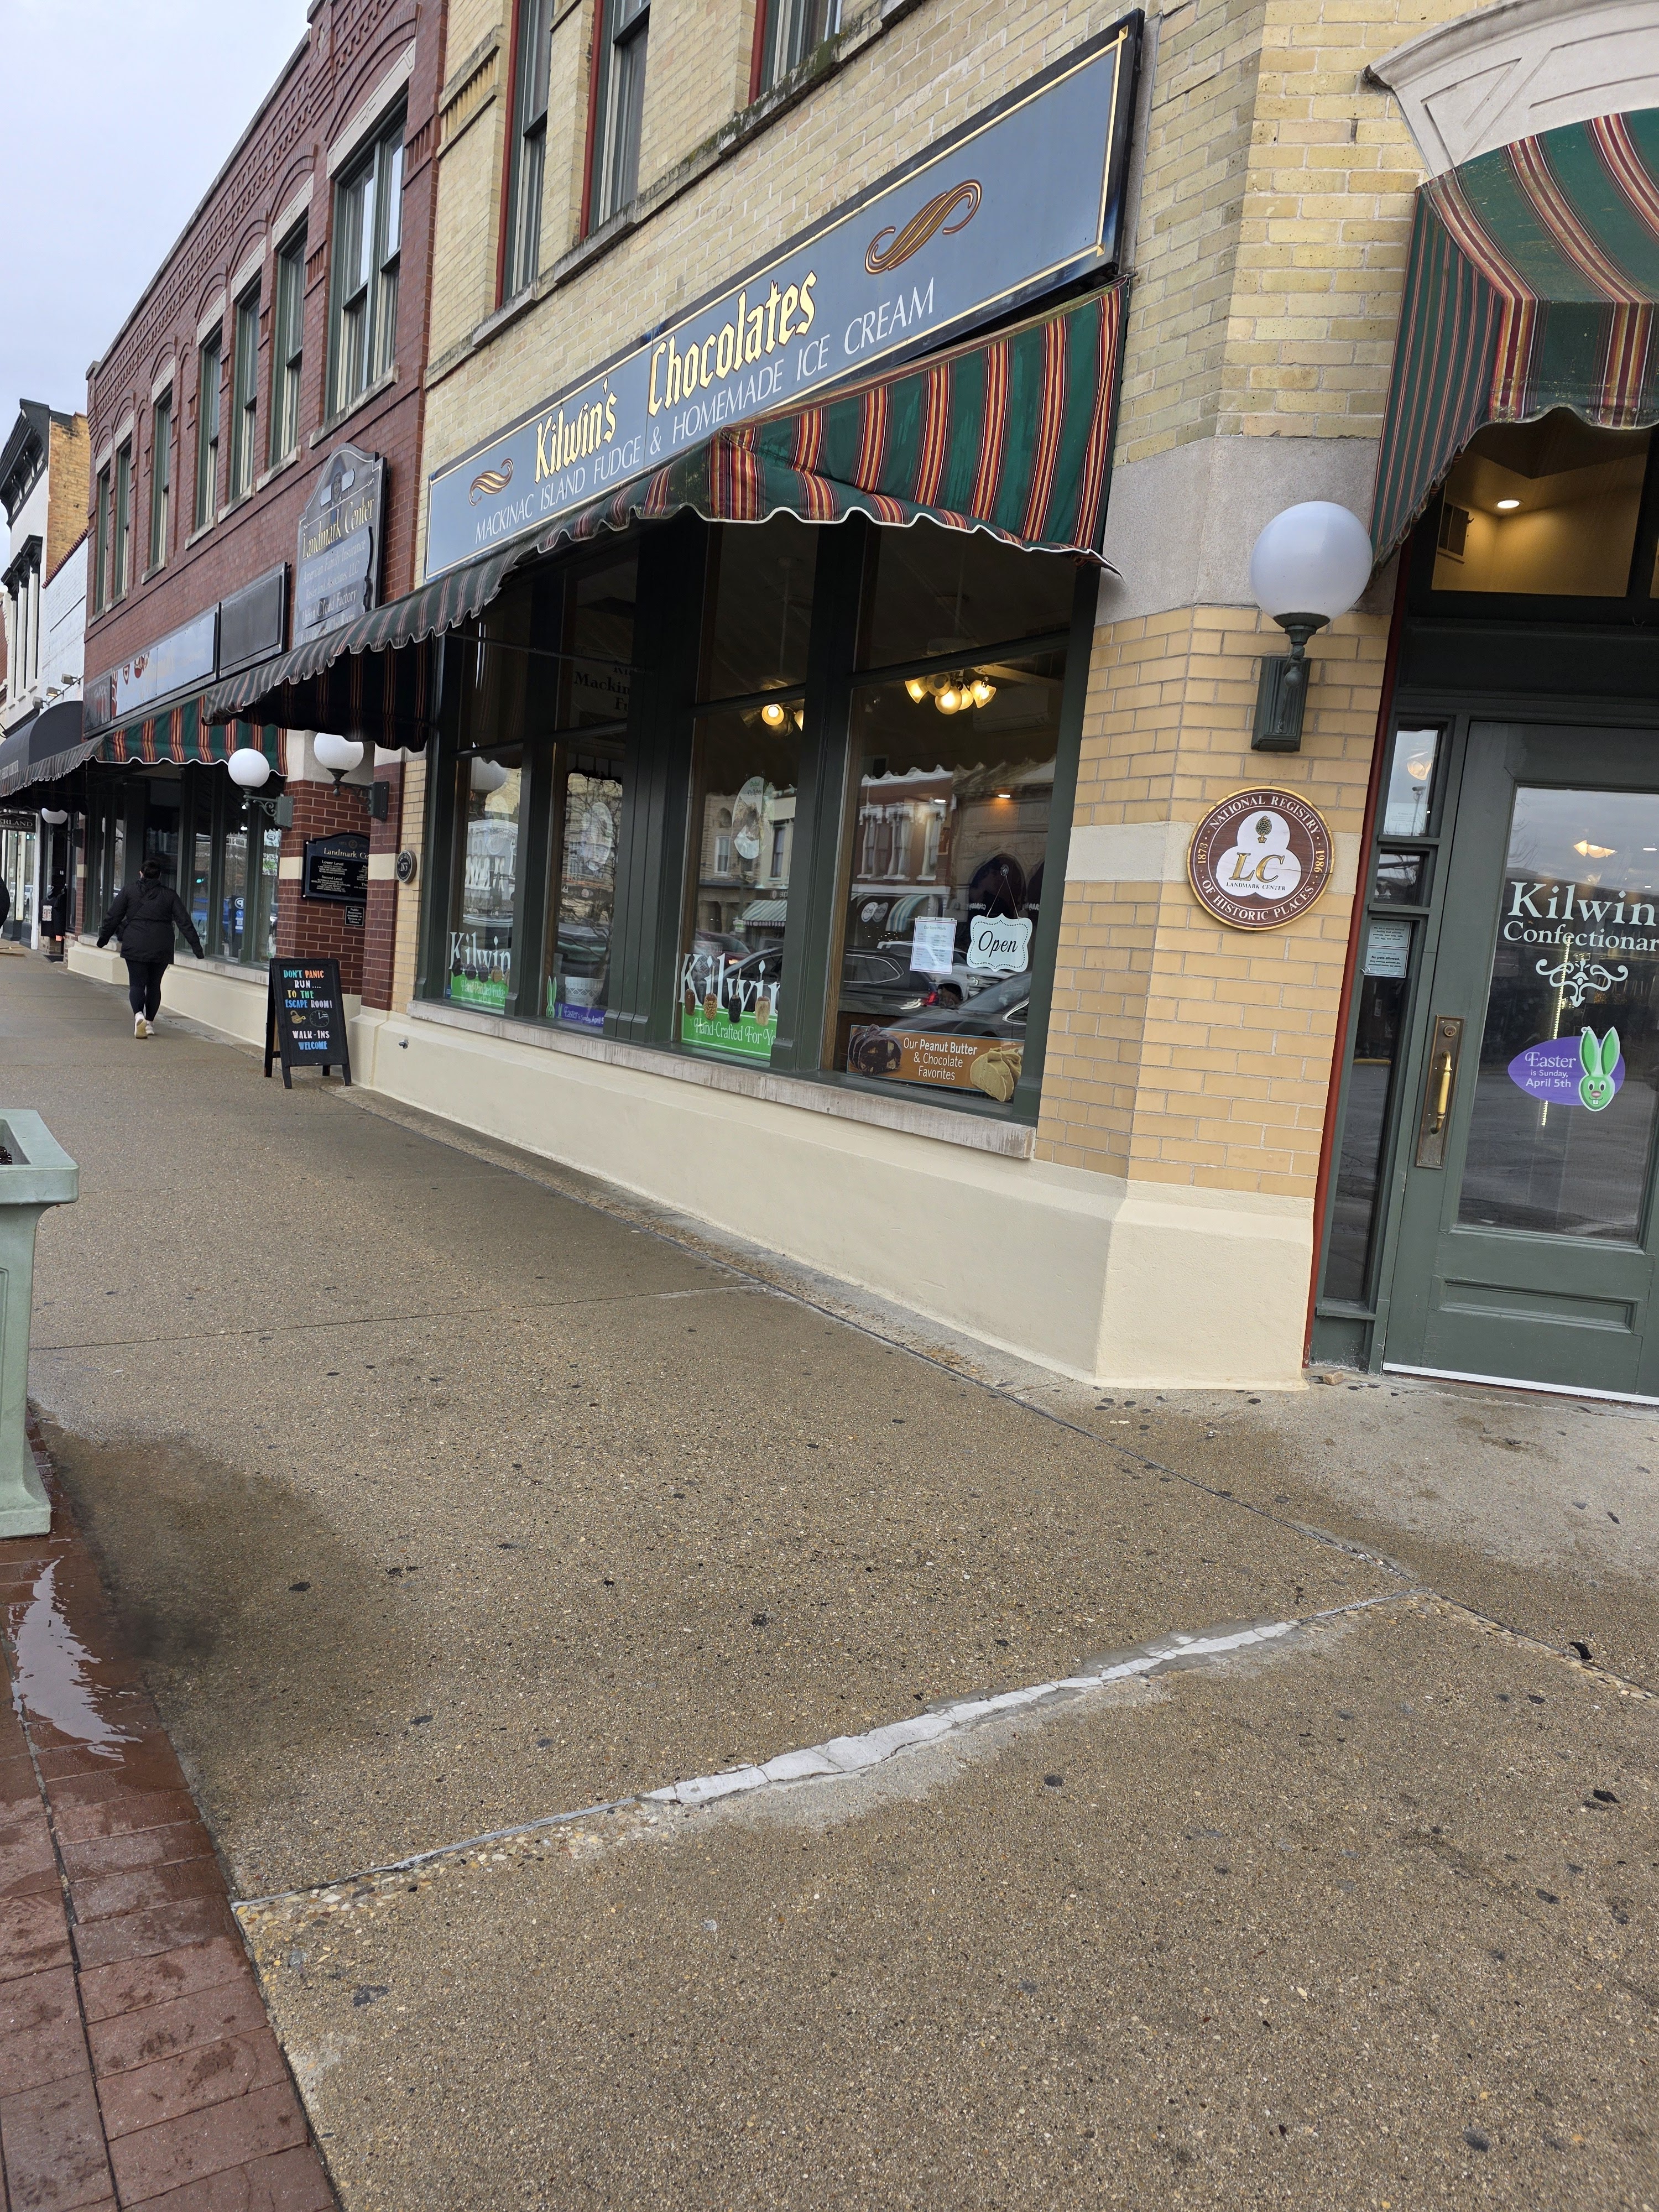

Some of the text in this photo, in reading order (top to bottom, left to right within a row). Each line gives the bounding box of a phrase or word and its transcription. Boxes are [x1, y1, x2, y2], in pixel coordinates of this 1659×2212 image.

[535, 270, 817, 484] Kilwin's Chocolates
[475, 276, 933, 544] MACKINAC ISLAND FUDGE & HOMEMADE ICE CREAM
[302, 497, 374, 561] Landmark Center
[342, 540, 366, 562] Insurance
[348, 560, 360, 578] LLC
[317, 594, 335, 617] Cloud
[336, 589, 357, 608] Factory
[1209, 795, 1321, 834] NATIONAL REGISTRY
[324, 847, 357, 858] Landmark
[1197, 842, 1208, 864] 1873
[1314, 849, 1325, 873] 1986
[1228, 852, 1286, 883] LC
[1202, 879, 1314, 921] OF HISTORIC PLACES
[978, 930, 1018, 958] Open
[283, 969, 324, 978] DON'T PANIC
[287, 989, 314, 999] TO THE
[285, 999, 332, 1008] ESCAPE ROOM!
[292, 1030, 330, 1039] WALK-INS
[693, 1018, 743, 1041] Hand-Crafted
[744, 1026, 762, 1044] For
[298, 1041, 328, 1050] WELCOME
[903, 1037, 978, 1055] Our Peanut Butter
[914, 1052, 963, 1068] & Chocolate
[1525, 1052, 1577, 1068] Easter
[919, 1065, 955, 1081] Favorites
[1538, 1070, 1568, 1078] Sunday,
[1526, 1078, 1571, 1088] April 5th
